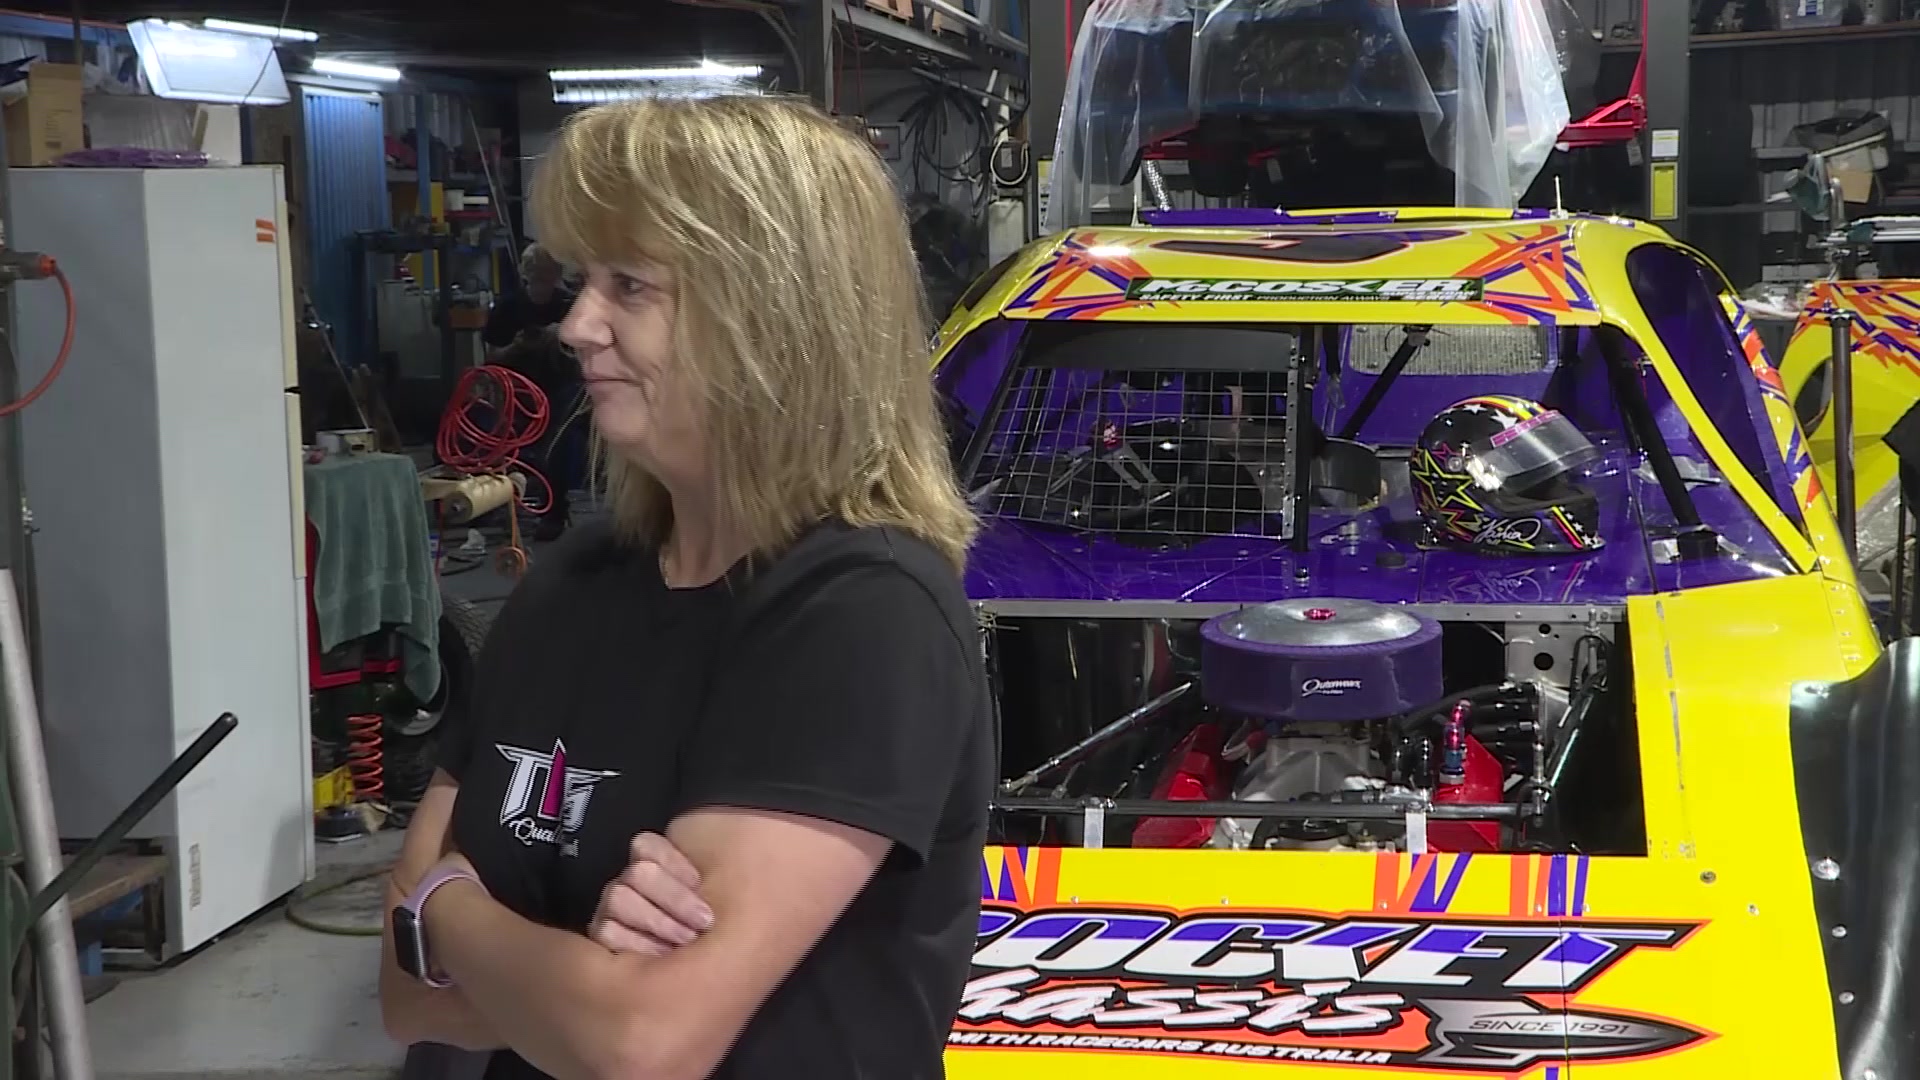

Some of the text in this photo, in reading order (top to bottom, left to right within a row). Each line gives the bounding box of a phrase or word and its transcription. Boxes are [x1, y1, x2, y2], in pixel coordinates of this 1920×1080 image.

[957, 967, 1405, 1032] hassis
[1468, 1019, 1631, 1035] SINCE 1991
[947, 1031, 1392, 1064] MITH RACECARS AUSTRALIA
